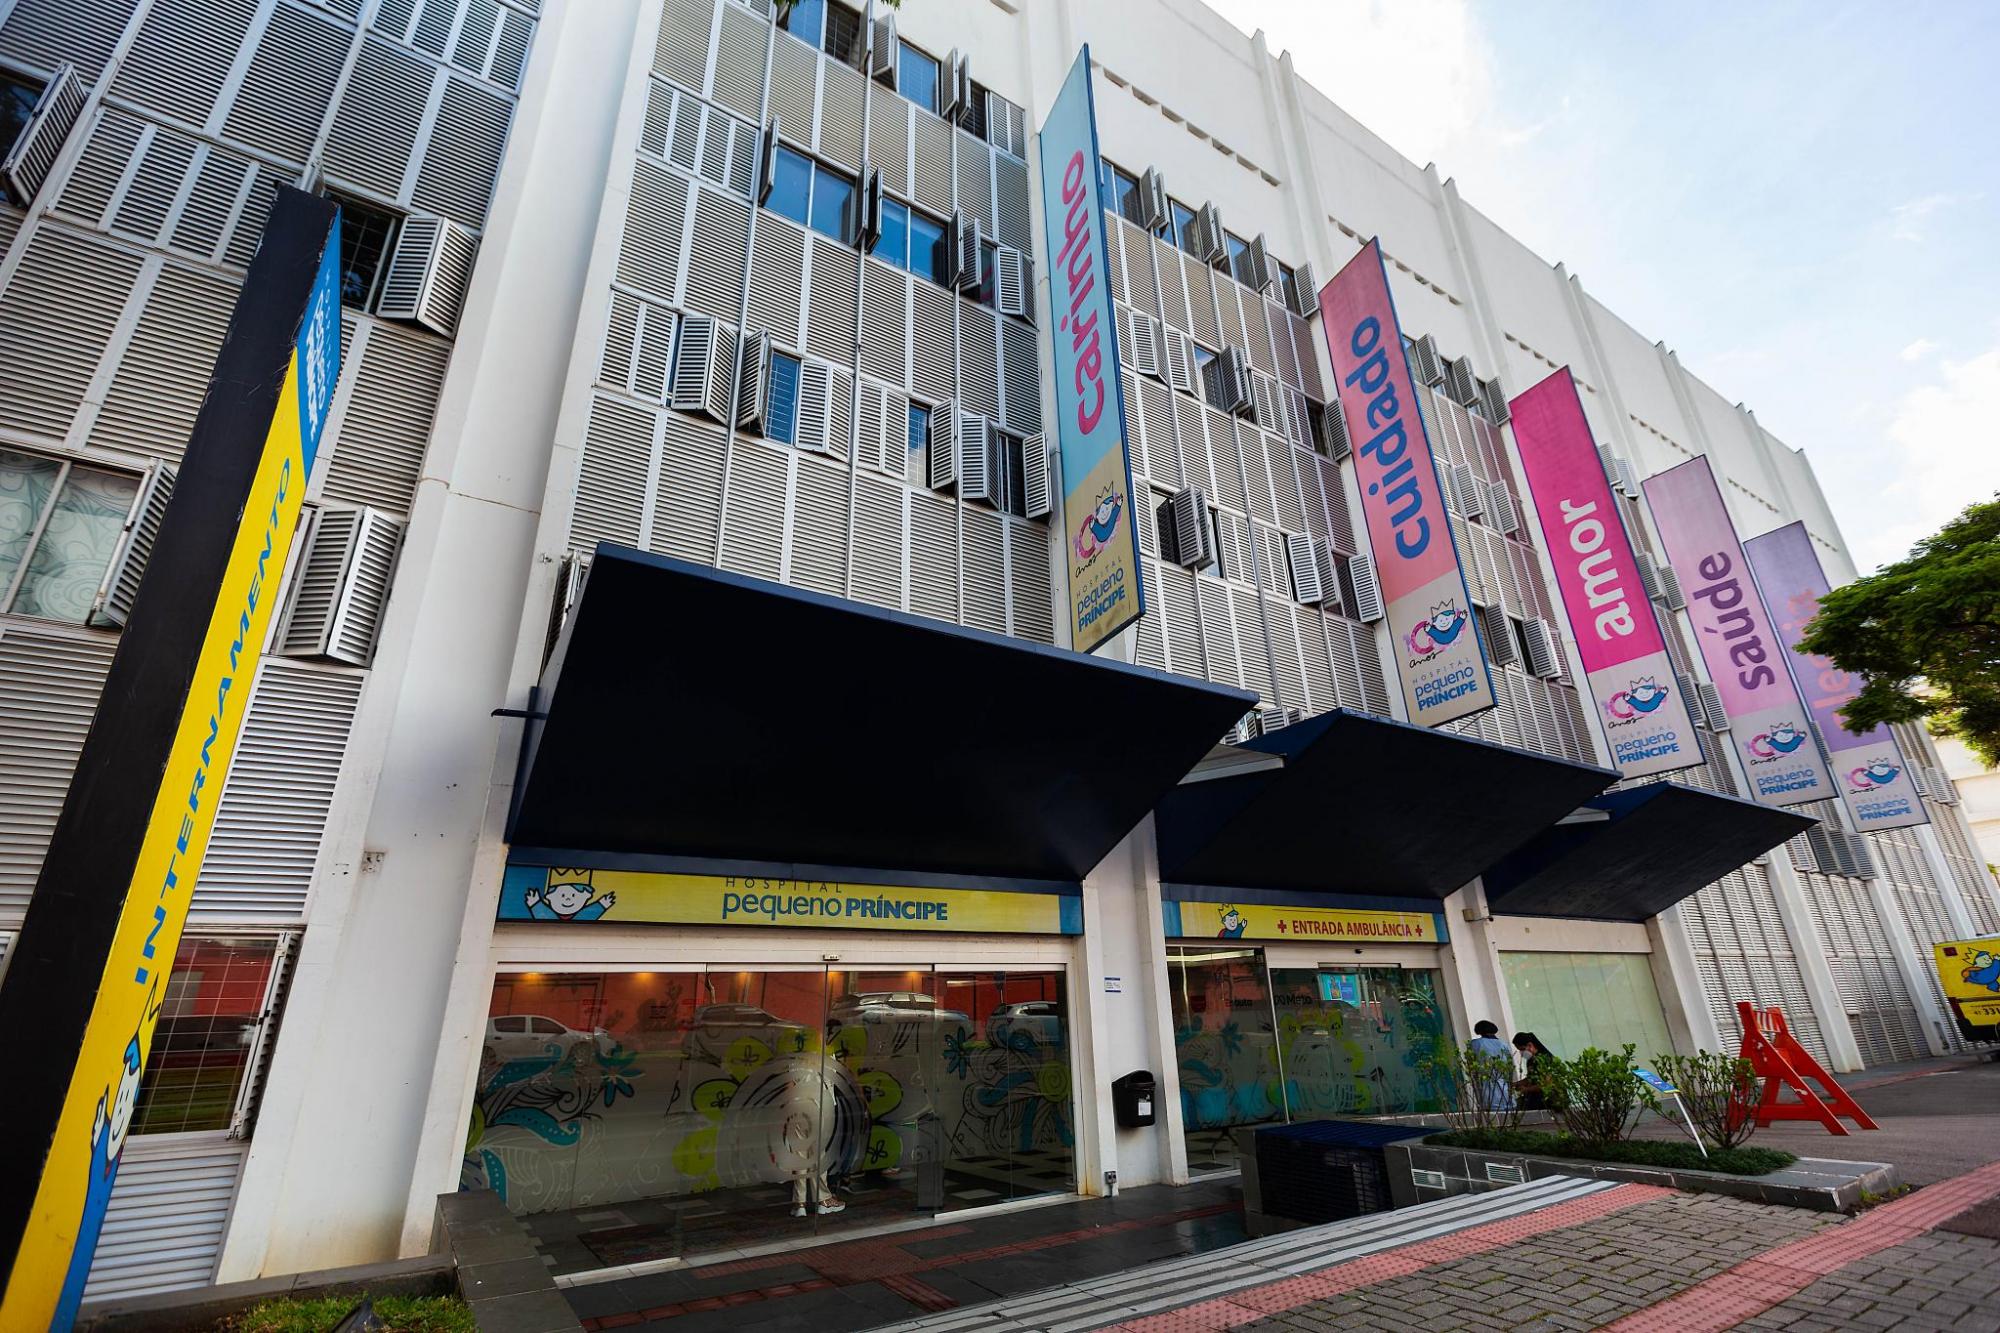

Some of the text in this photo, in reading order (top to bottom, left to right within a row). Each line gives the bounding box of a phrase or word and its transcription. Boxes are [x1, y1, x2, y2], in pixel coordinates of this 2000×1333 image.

[1057, 150, 1104, 435] carinho
[1345, 315, 1431, 560] cuidado
[1559, 499, 1636, 641] amor
[1077, 568, 1124, 615] pequeno
[1078, 585, 1126, 632] PRÍNCIPE
[1692, 551, 1776, 691] saúde
[1414, 666, 1474, 701] pequeno
[1418, 680, 1478, 711] PRÍNCIPE
[135, 457, 290, 985] INTERNAMENTO
[1615, 731, 1676, 755] pequeno
[1618, 743, 1680, 764] PRÍNCIPE
[1757, 769, 1814, 788] pequeno
[725, 877, 842, 894] HOSPITAL
[722, 892, 948, 921] pequeno PRÍNCIPE
[1292, 920, 1412, 937] ENTRADA AMBULÂNCIA
